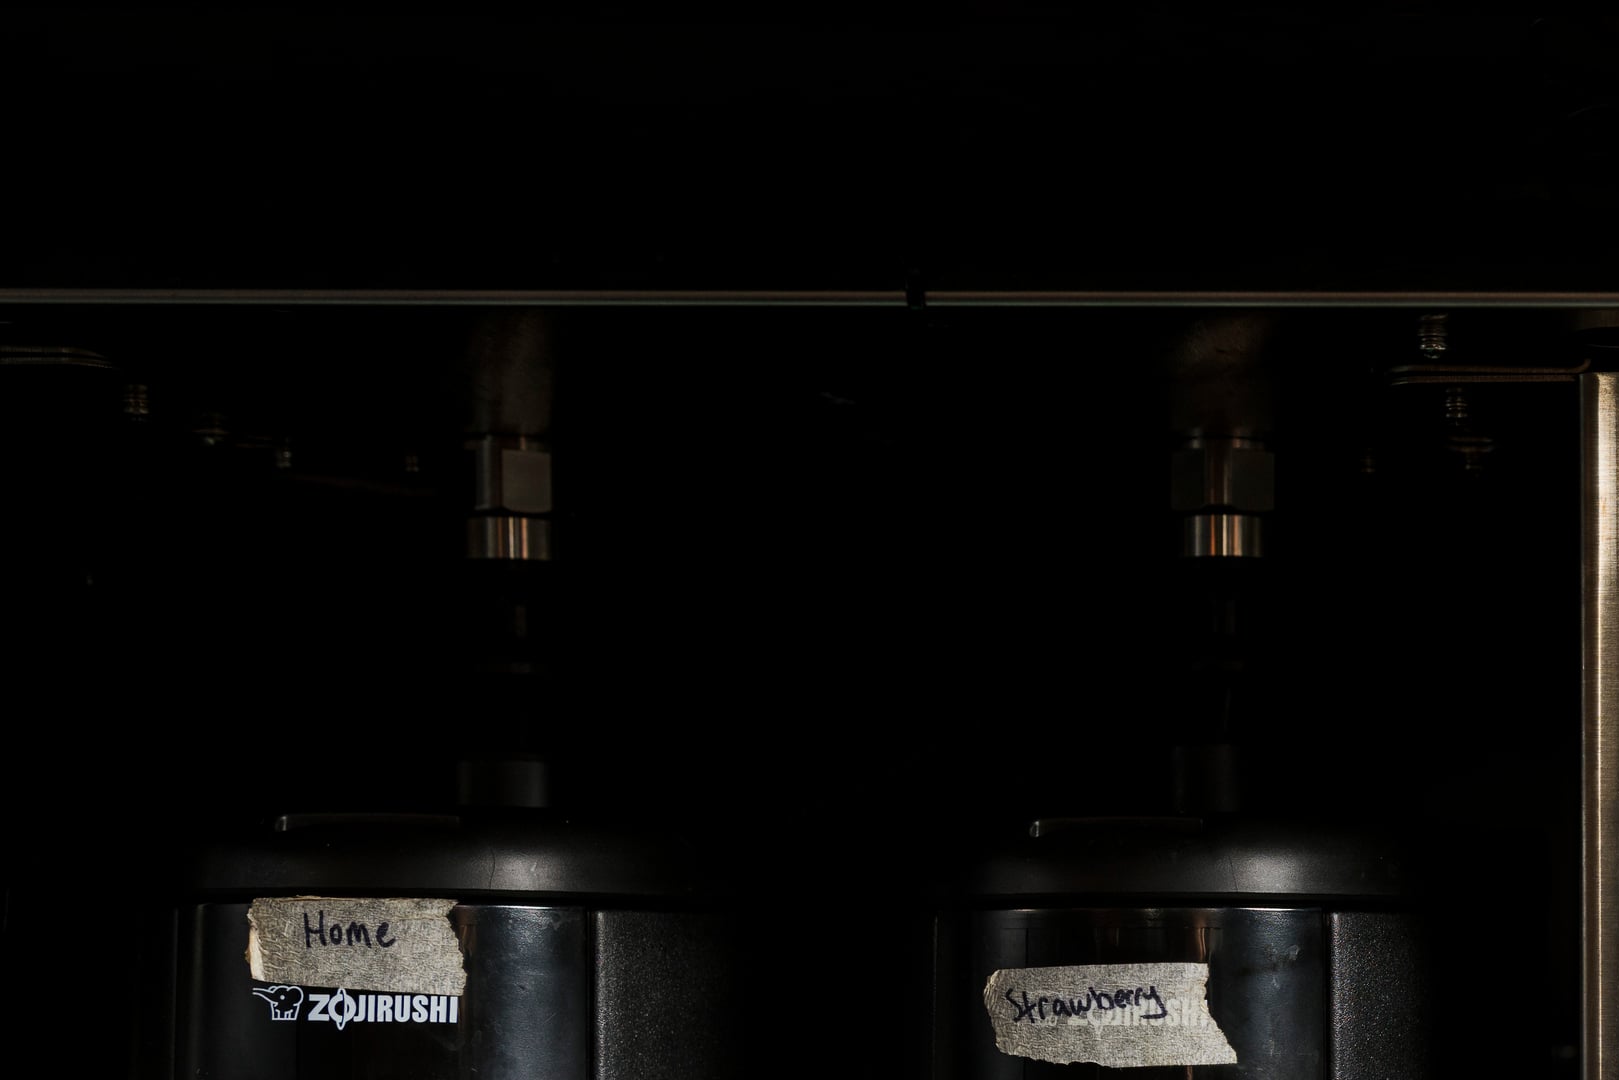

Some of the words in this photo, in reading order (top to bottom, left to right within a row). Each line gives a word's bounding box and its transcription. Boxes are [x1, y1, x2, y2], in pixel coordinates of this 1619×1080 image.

[303, 910, 397, 948] Home
[307, 988, 458, 1031] ZOJIRUSHI
[1005, 985, 1168, 1024] Strawberry
